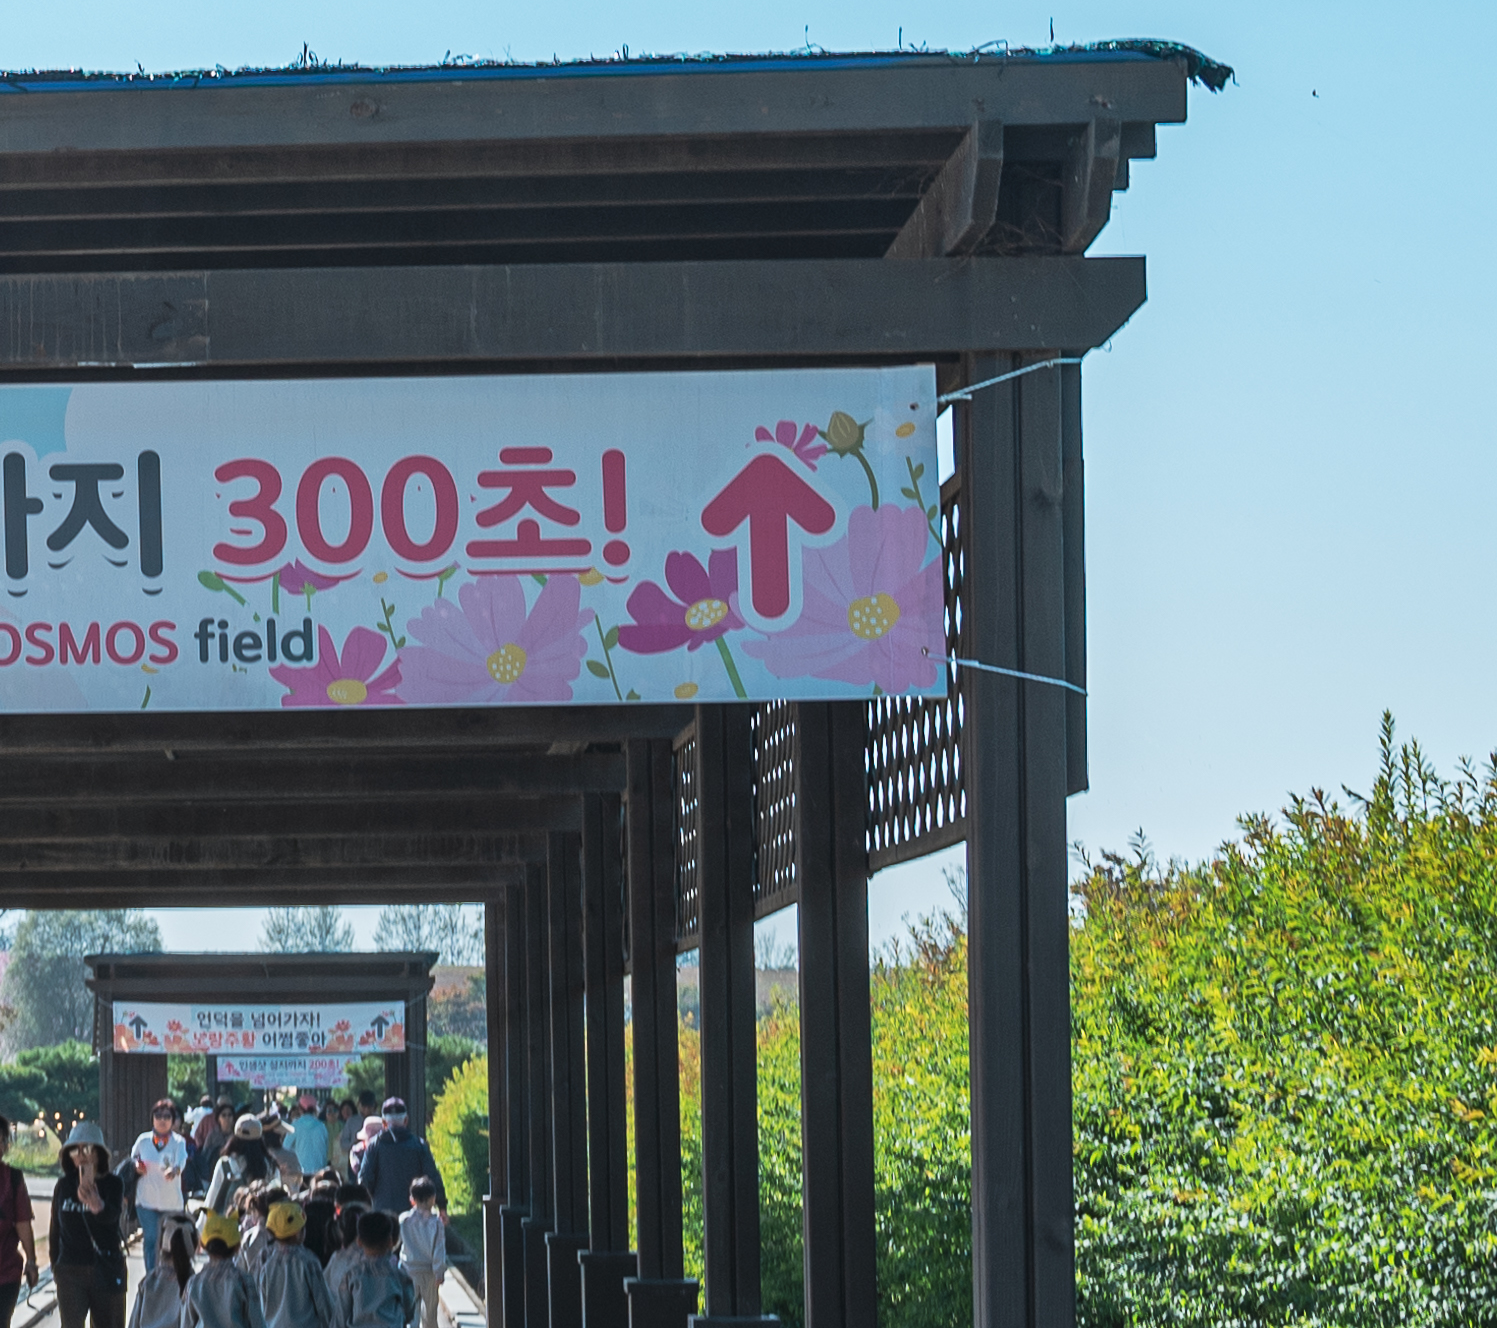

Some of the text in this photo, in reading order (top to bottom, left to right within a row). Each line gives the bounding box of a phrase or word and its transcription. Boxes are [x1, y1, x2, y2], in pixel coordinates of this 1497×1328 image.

[212, 446, 630, 566] 300초!
[194, 617, 314, 664] field
[196, 1011, 320, 1029] 언덕을 넘어가자!
